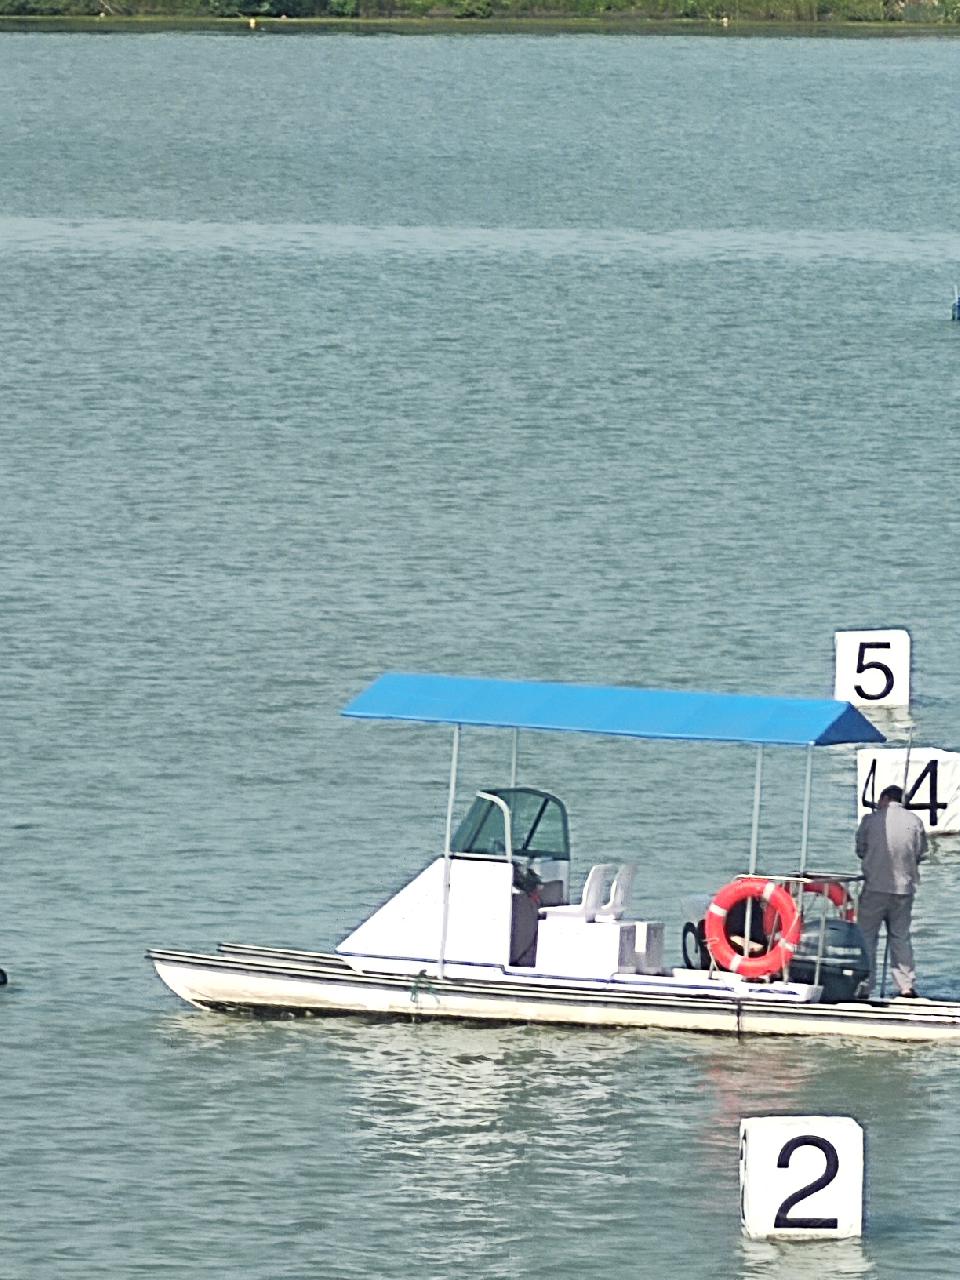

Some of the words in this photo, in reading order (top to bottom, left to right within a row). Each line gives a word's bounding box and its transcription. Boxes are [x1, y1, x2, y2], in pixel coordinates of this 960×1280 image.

[854, 642, 894, 700] 5
[905, 760, 948, 826] 4
[774, 1135, 839, 1229] 2
